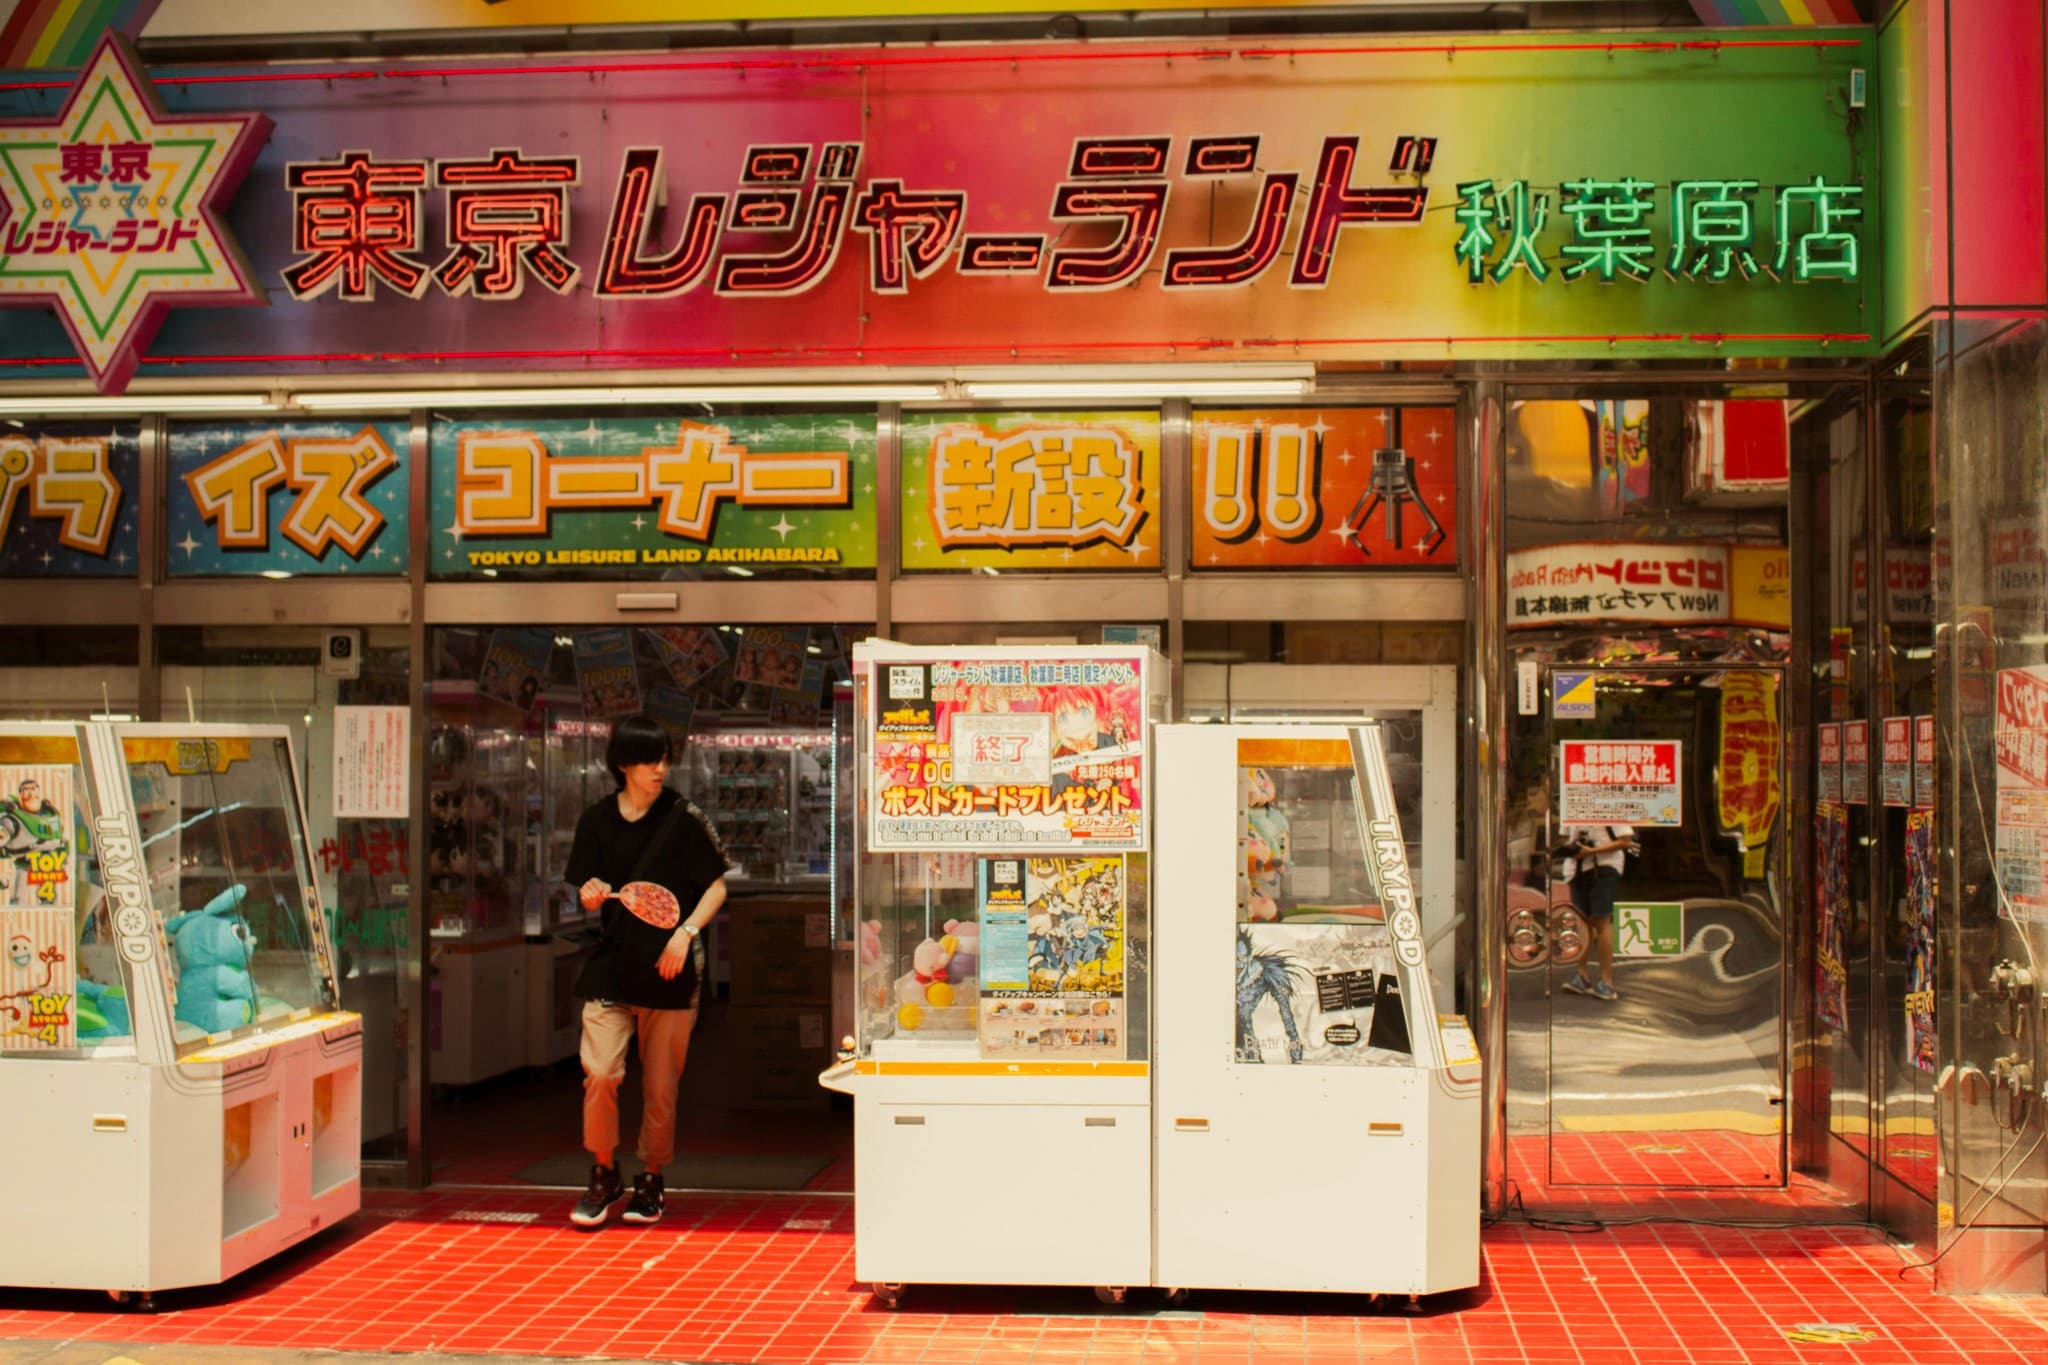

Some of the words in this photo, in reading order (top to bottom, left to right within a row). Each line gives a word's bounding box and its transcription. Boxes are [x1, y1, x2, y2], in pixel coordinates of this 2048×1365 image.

[59, 141, 153, 184] 東京
[280, 135, 1437, 301] 東京レジャーランド
[1455, 176, 1863, 284] 秋葉原店
[4, 219, 199, 254] レジャーランド
[459, 421, 848, 540] コーナー
[932, 426, 1140, 545] 新設
[468, 551, 540, 565] TOKYO
[546, 549, 637, 564] LEISURE
[642, 548, 701, 563] LAND
[706, 547, 840, 563] AKIHABARA
[975, 735, 1030, 762] 終了
[882, 785, 1132, 816] ポストカードプレゼント
[27, 852, 67, 872] TOY
[37, 881, 56, 903] 4
[95, 811, 153, 962] TRYPOD
[1370, 815, 1425, 967] TRYPOD
[28, 994, 70, 1015] TOY
[38, 1024, 57, 1045] 4
